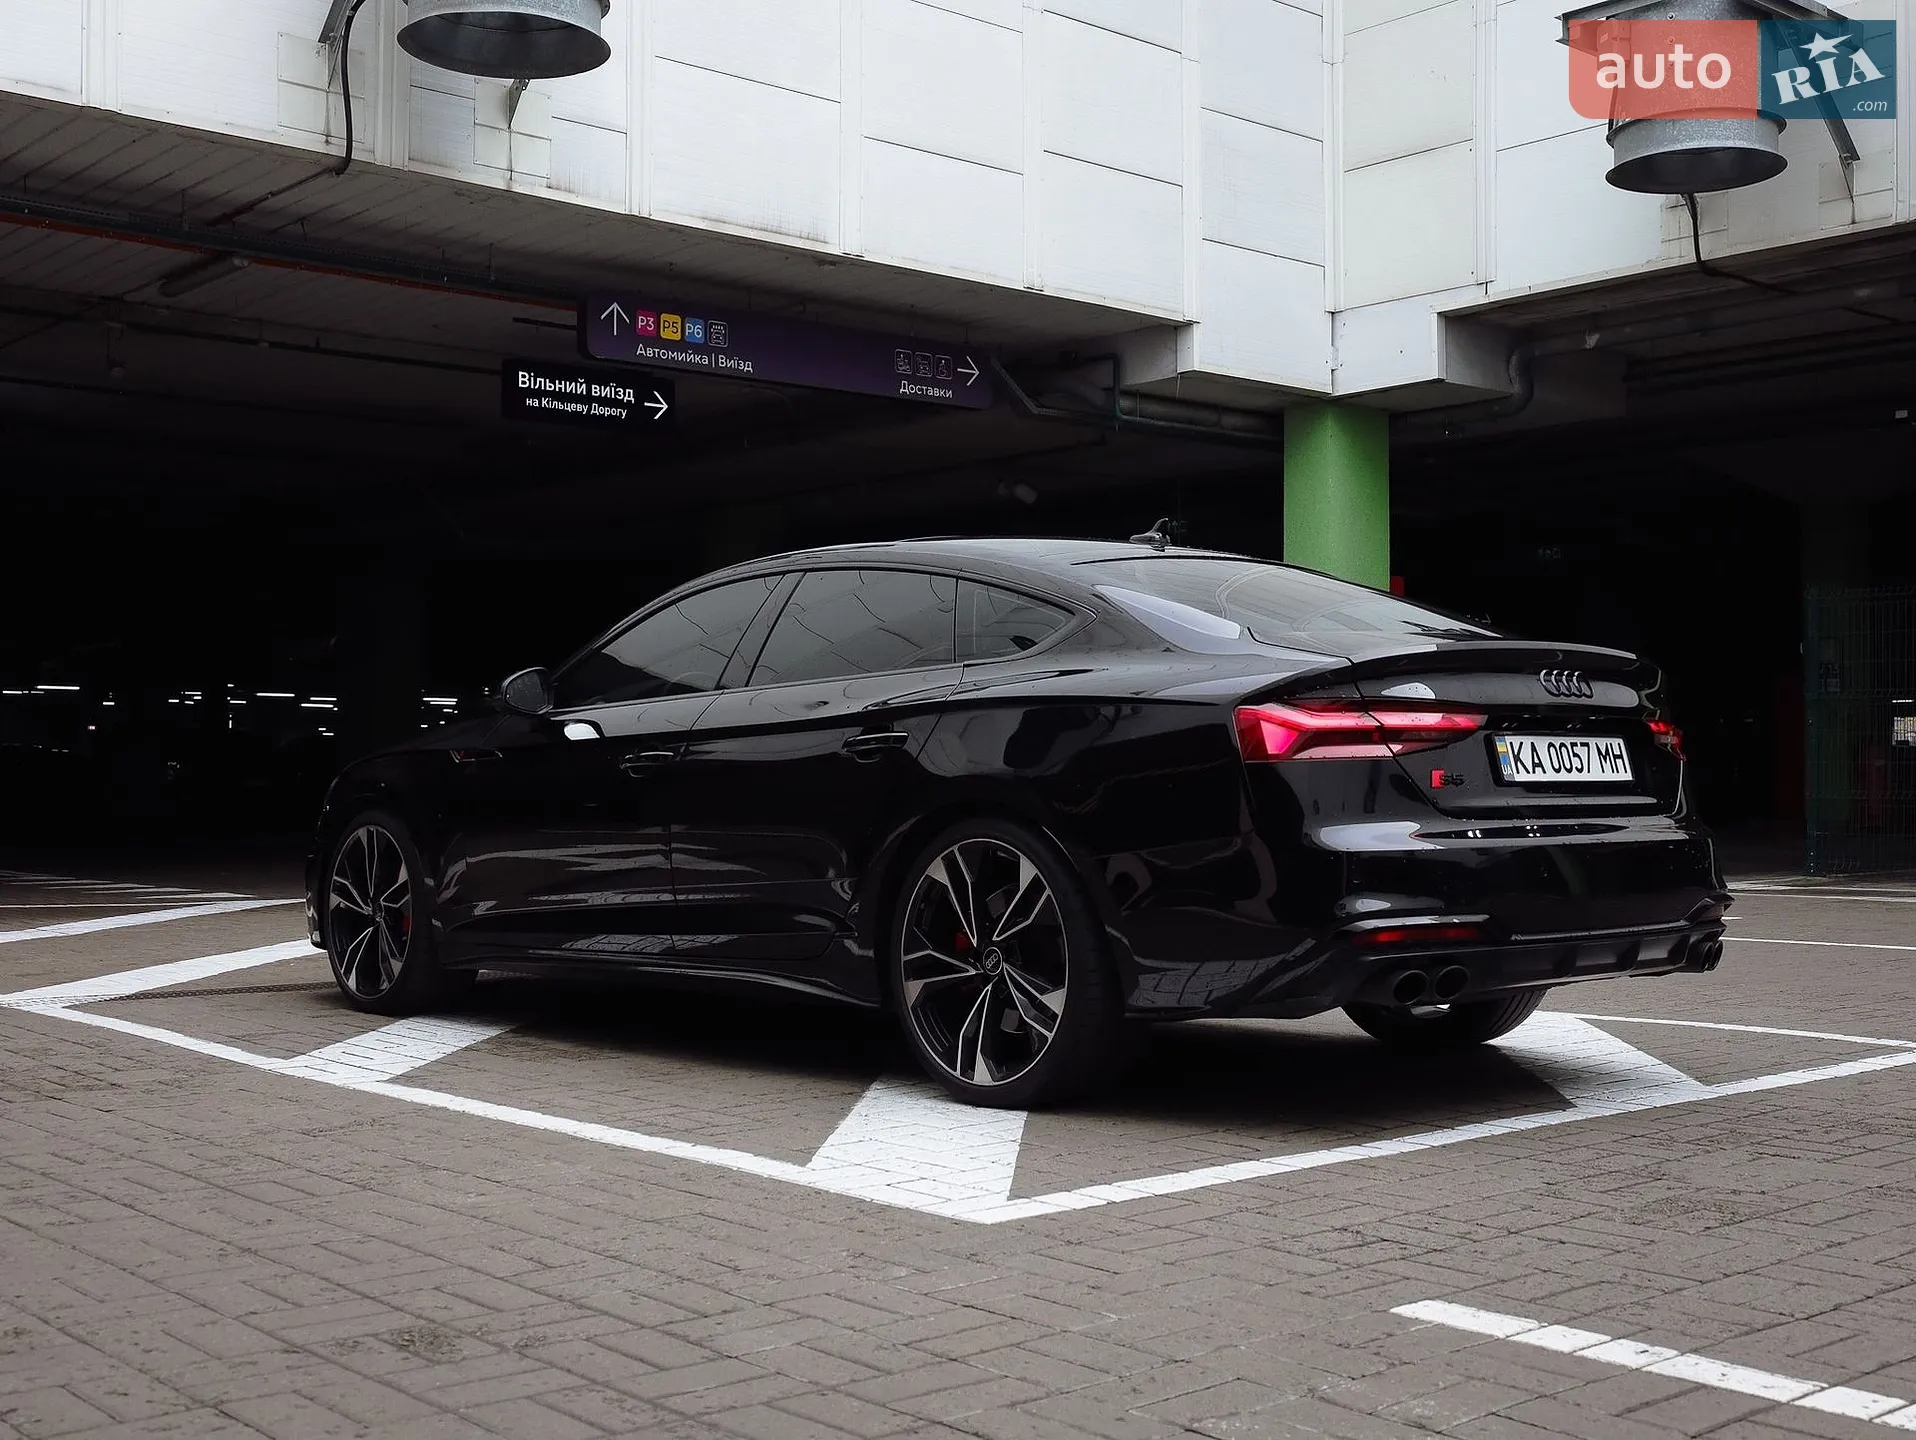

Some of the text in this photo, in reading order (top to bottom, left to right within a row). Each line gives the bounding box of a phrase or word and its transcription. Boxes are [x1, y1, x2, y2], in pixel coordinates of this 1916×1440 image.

[637, 315, 703, 338] P3 P5 P6
[636, 343, 709, 365] Автомийка
[718, 354, 754, 373] Виїзд
[518, 370, 635, 404] Вільний виїзд
[899, 380, 953, 398] Доставки
[526, 396, 628, 419] на Кільцеву Дорогу
[1509, 741, 1628, 774] KA 0057 MH
[1501, 764, 1514, 775] UA
